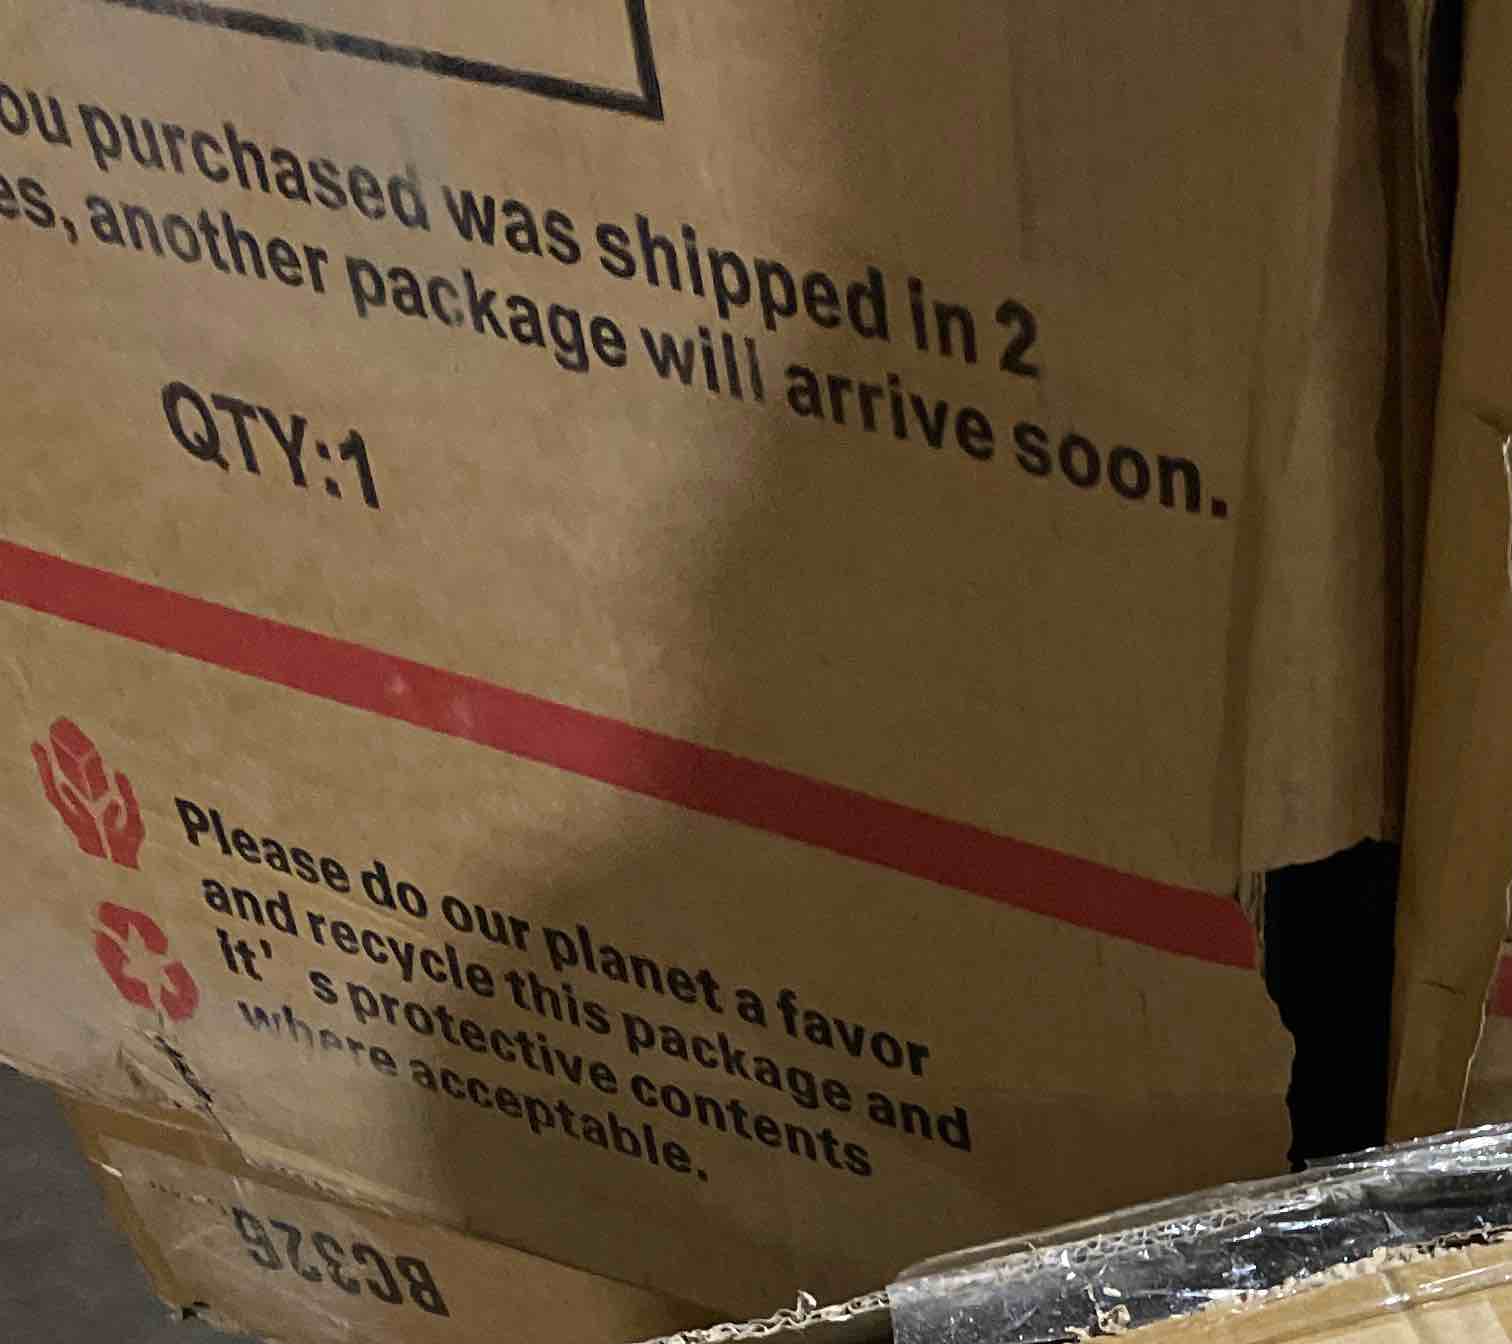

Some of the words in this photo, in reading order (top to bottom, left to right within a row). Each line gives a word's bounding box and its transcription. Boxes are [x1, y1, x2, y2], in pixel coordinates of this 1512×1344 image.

[79, 101, 430, 231] purchased
[442, 183, 582, 266] was
[595, 212, 892, 342] shipped
[907, 276, 979, 364] in
[994, 299, 1040, 379] 2
[85, 192, 328, 294] another
[346, 253, 628, 373] package
[640, 322, 765, 403] will
[783, 358, 997, 462] arrive
[1013, 418, 1229, 518] soon.
[160, 380, 381, 510] QTY:1
[174, 795, 350, 894] Please
[360, 860, 429, 919] do
[441, 896, 531, 952] our
[542, 923, 724, 1014] planet
[735, 988, 767, 1029] a
[776, 988, 931, 1077] favor
[201, 877, 299, 937] and
[306, 908, 496, 999] recycle
[502, 968, 612, 1035] this
[621, 1008, 853, 1112] package
[866, 1089, 973, 1152] and
[237, 1000, 399, 1078] where
[408, 1055, 710, 1184] acceptable.
[350, 980, 619, 1096] protective
[629, 1073, 873, 1177] contents
[231, 1204, 450, 1319] BC326
